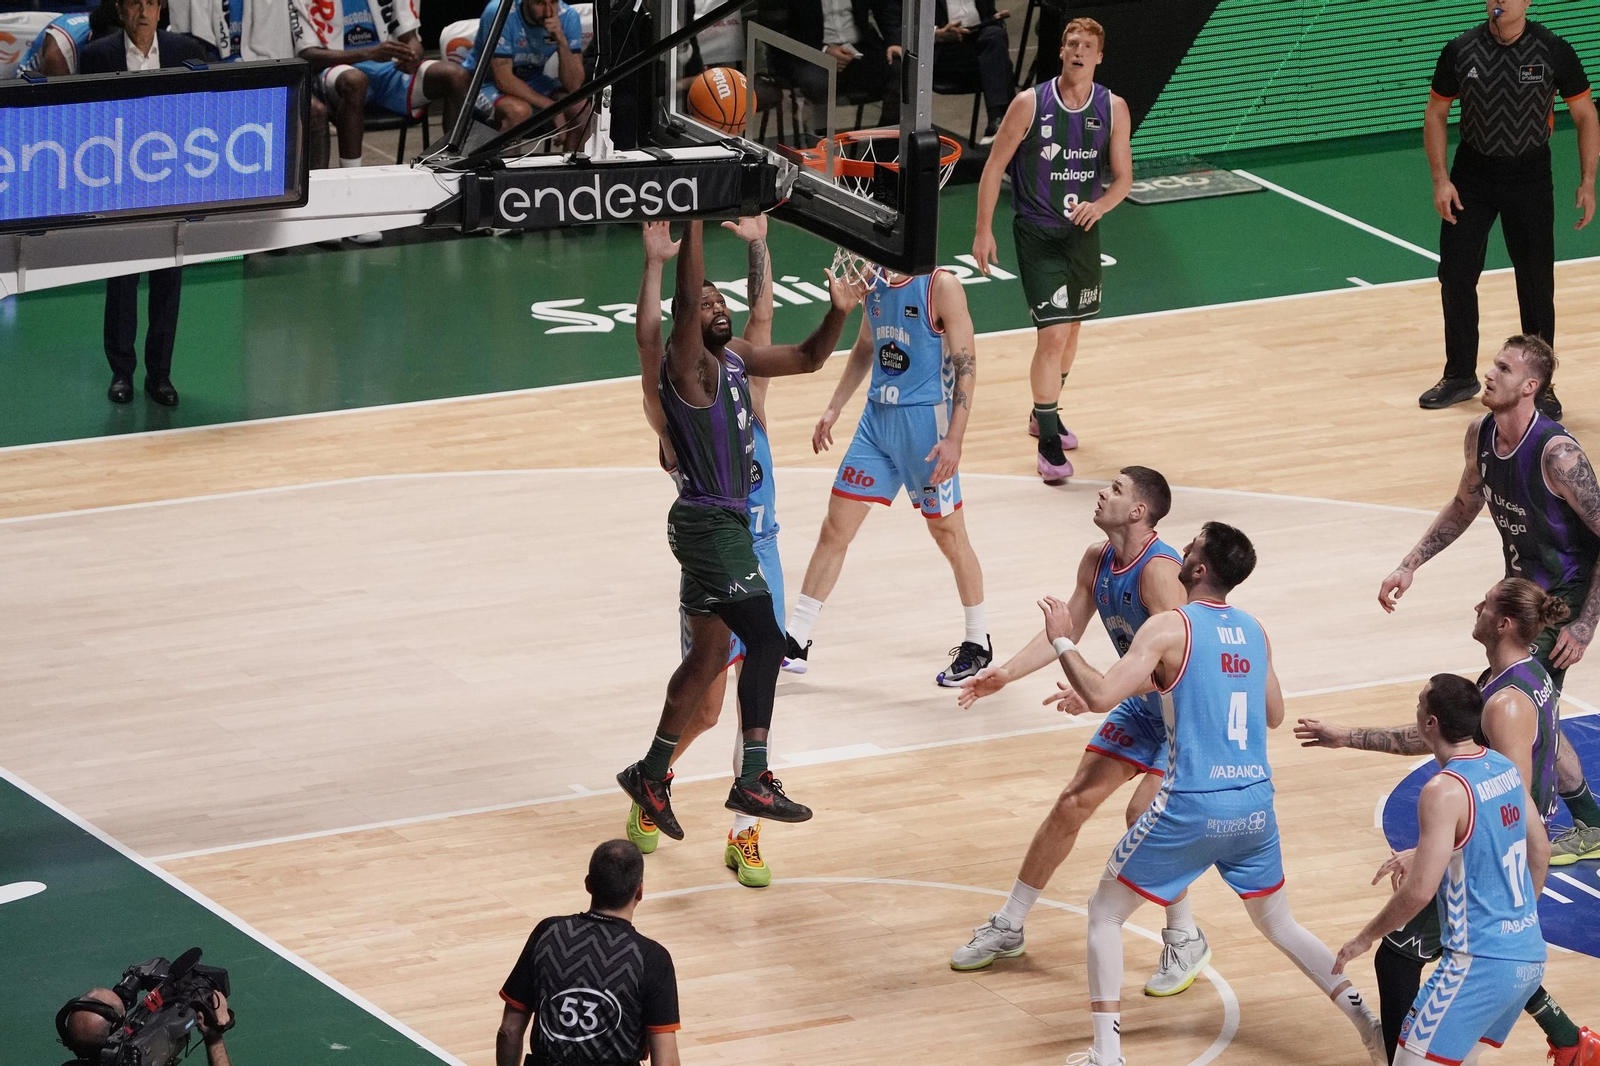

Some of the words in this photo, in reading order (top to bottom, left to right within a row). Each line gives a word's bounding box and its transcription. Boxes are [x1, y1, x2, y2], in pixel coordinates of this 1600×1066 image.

[499, 173, 698, 222] endesa
[880, 384, 900, 405] 19
[841, 465, 875, 488] Río
[1509, 544, 1522, 572] 2
[1216, 626, 1247, 645] VILA
[1227, 691, 1248, 750] 4
[1098, 721, 1134, 748] Río
[559, 996, 599, 1031] 53
